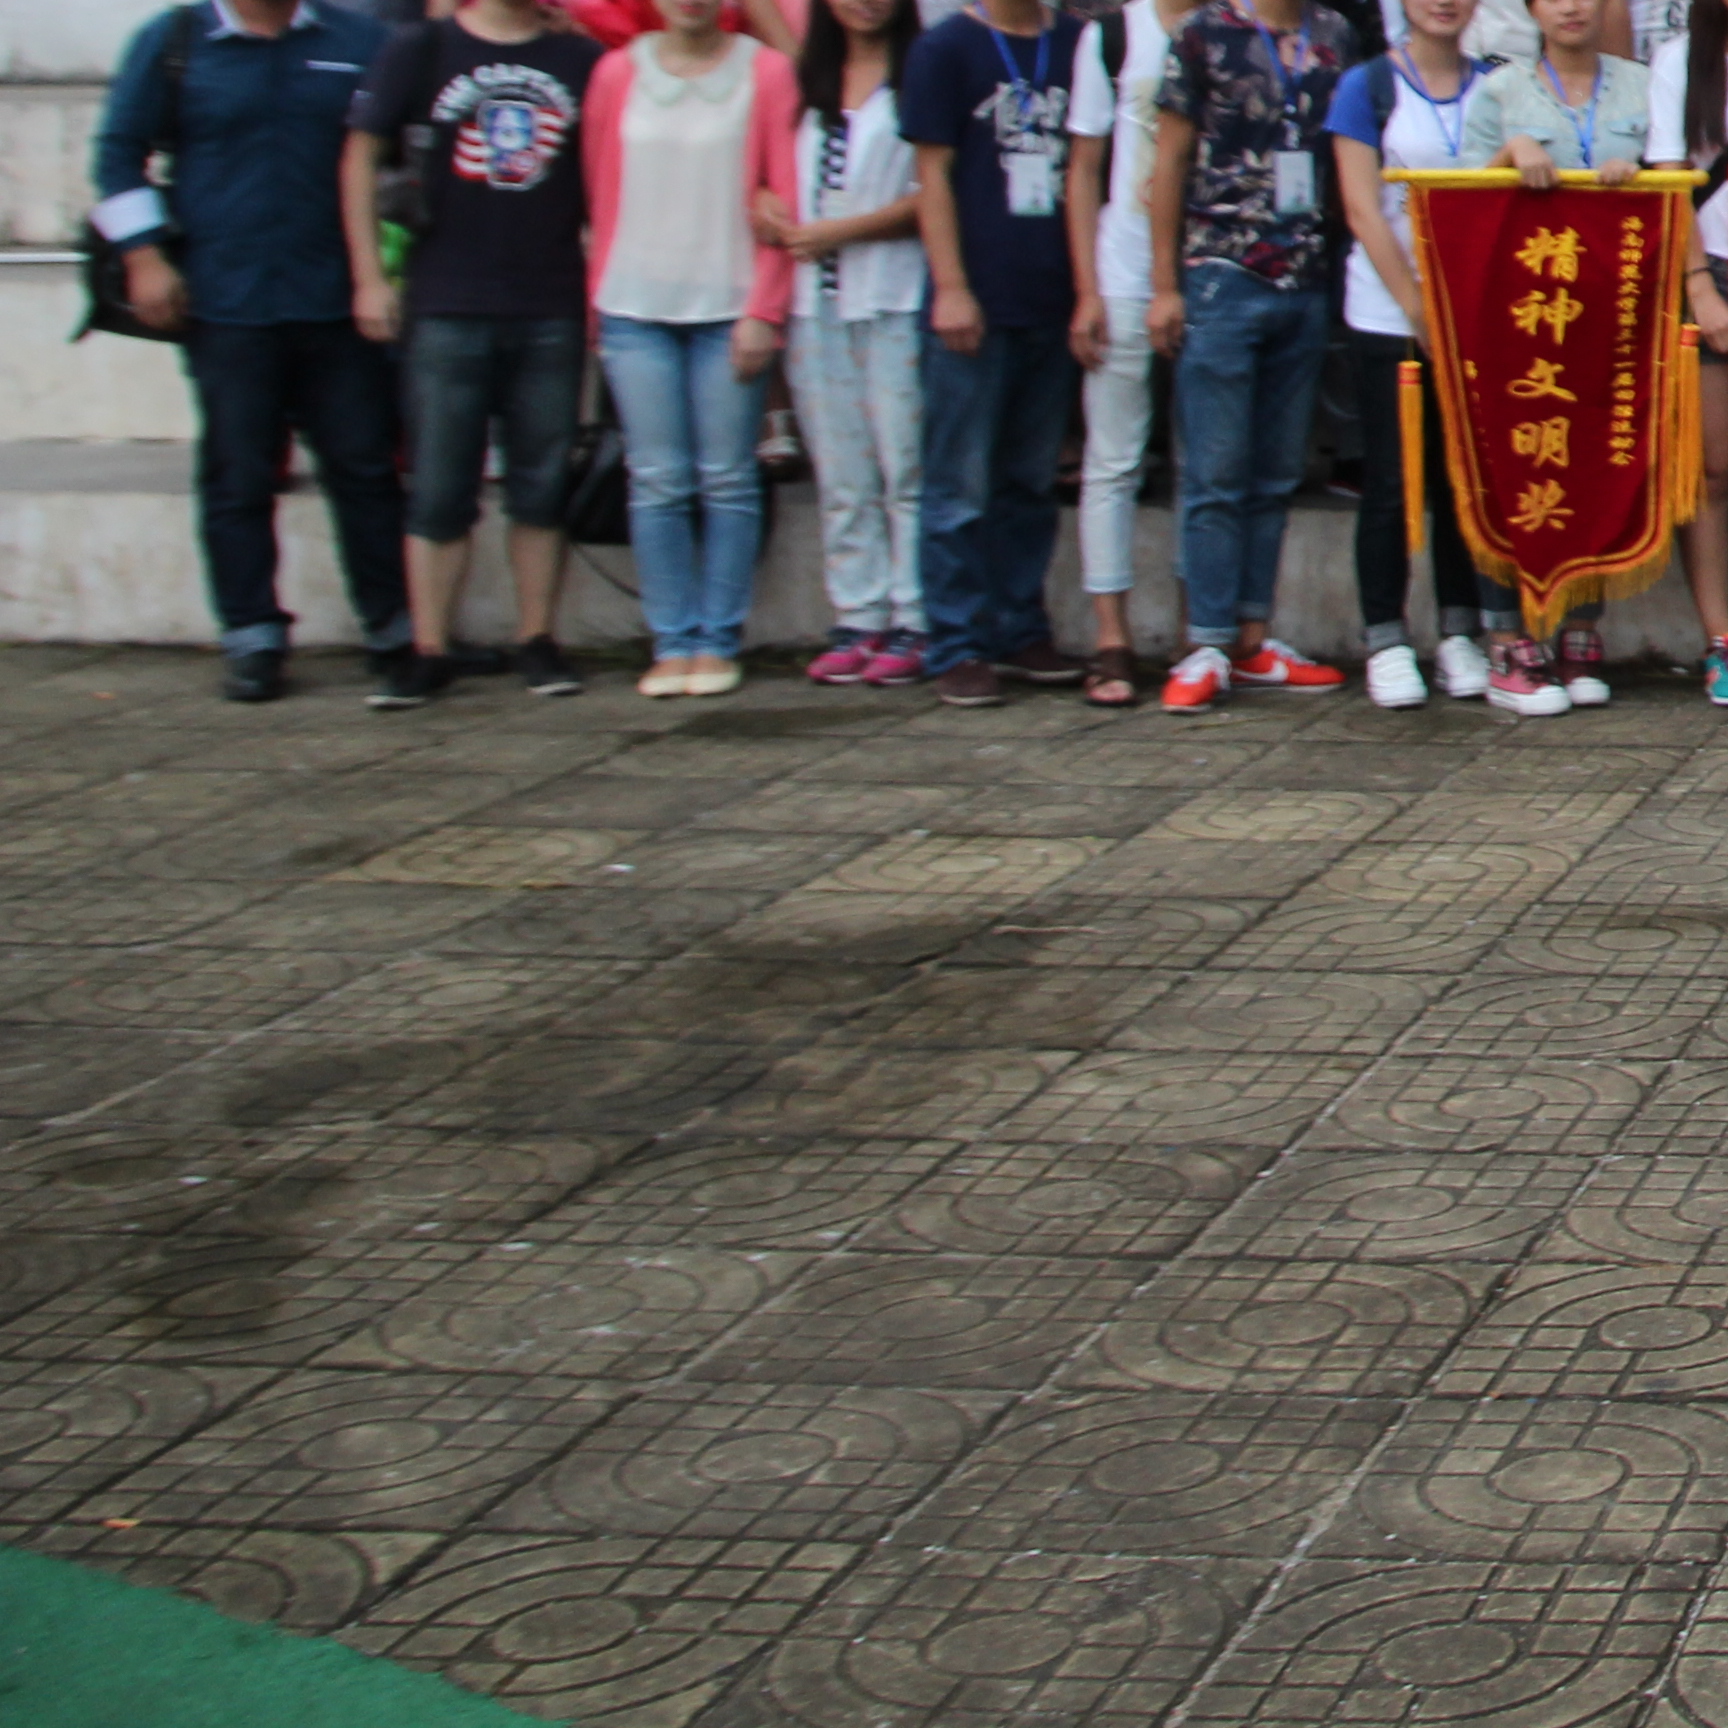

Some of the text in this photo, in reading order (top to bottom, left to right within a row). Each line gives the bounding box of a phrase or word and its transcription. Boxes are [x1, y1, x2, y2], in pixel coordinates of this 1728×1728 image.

[1508, 225, 1588, 532] 精神文明奖
